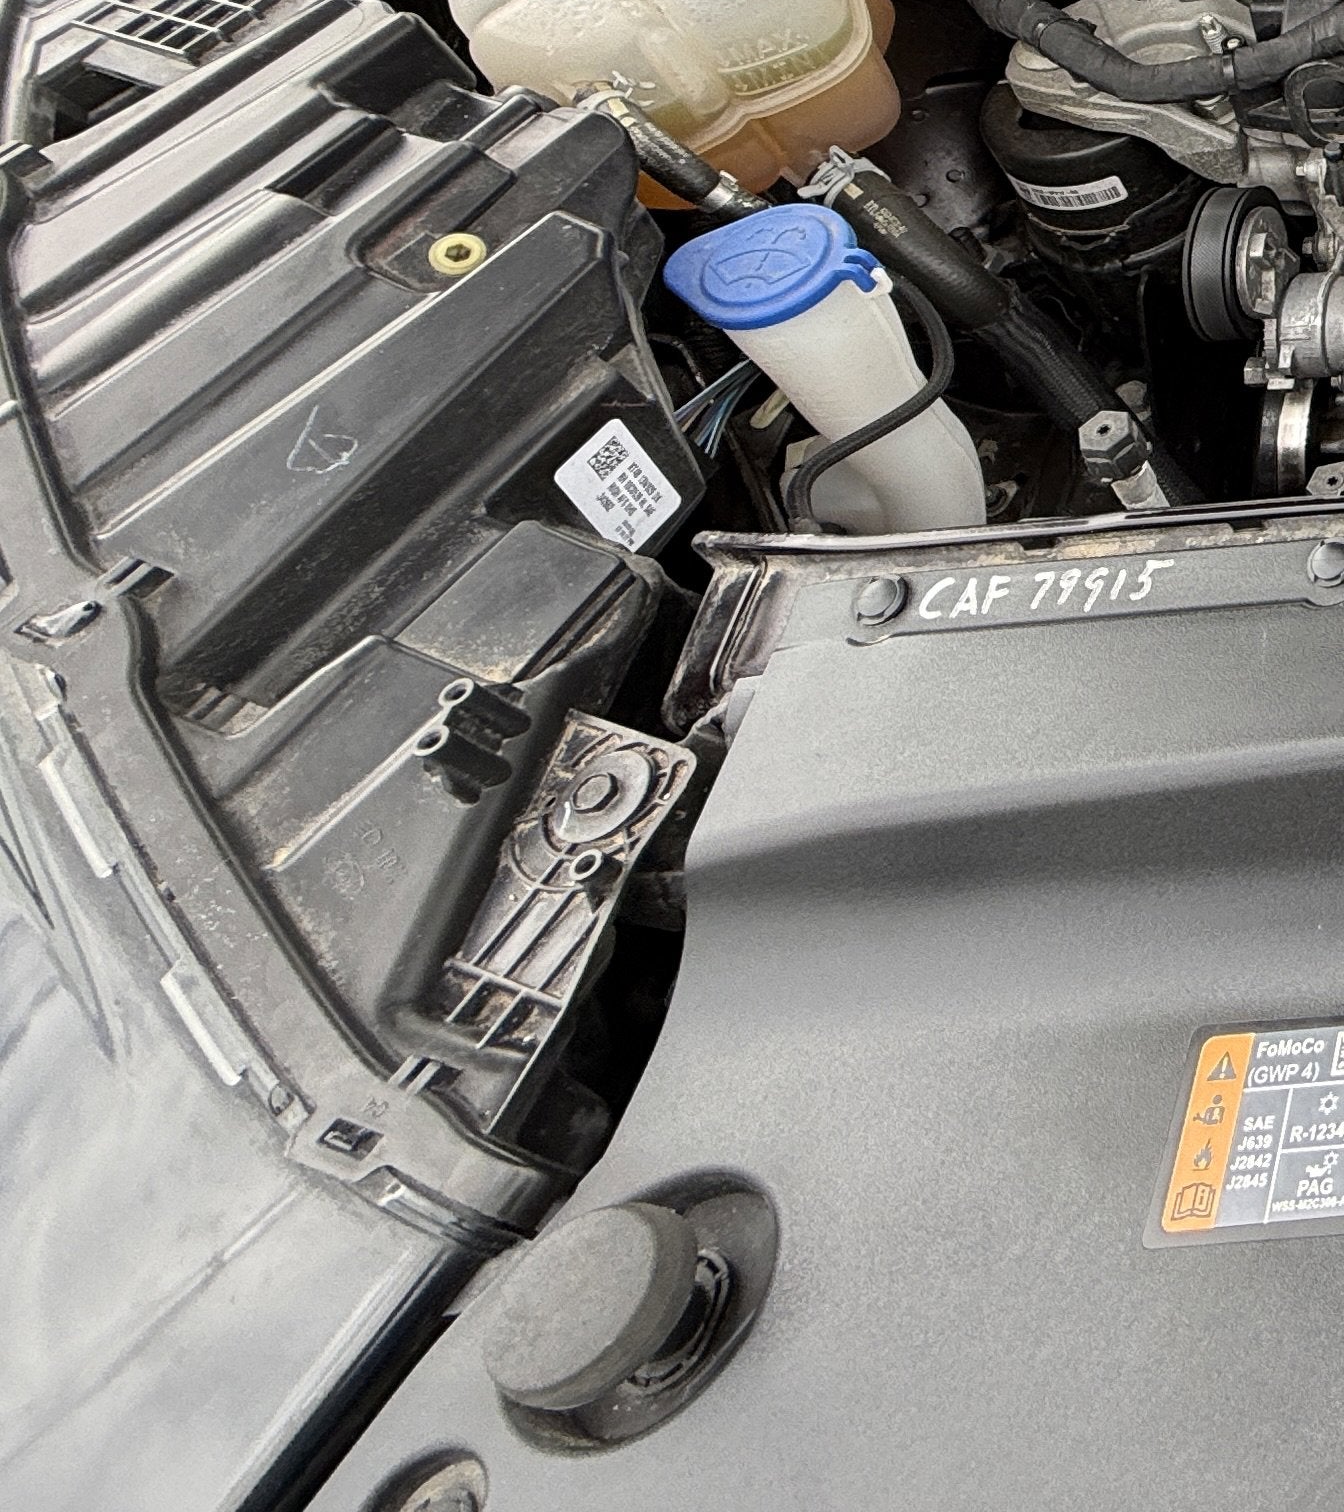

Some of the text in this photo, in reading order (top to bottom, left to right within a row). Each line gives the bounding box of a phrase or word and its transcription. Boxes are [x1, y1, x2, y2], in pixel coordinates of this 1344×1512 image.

[918, 558, 1175, 620] CAF 79915
[1256, 1037, 1326, 1059] FoMoCo
[1247, 1061, 1321, 1087] (GWP 4)
[1243, 1115, 1275, 1133] SAE
[1237, 1134, 1273, 1152] J639
[1229, 1153, 1272, 1171] J2842
[1226, 1172, 1268, 1190] J2845
[1296, 1178, 1334, 1198] PAG
